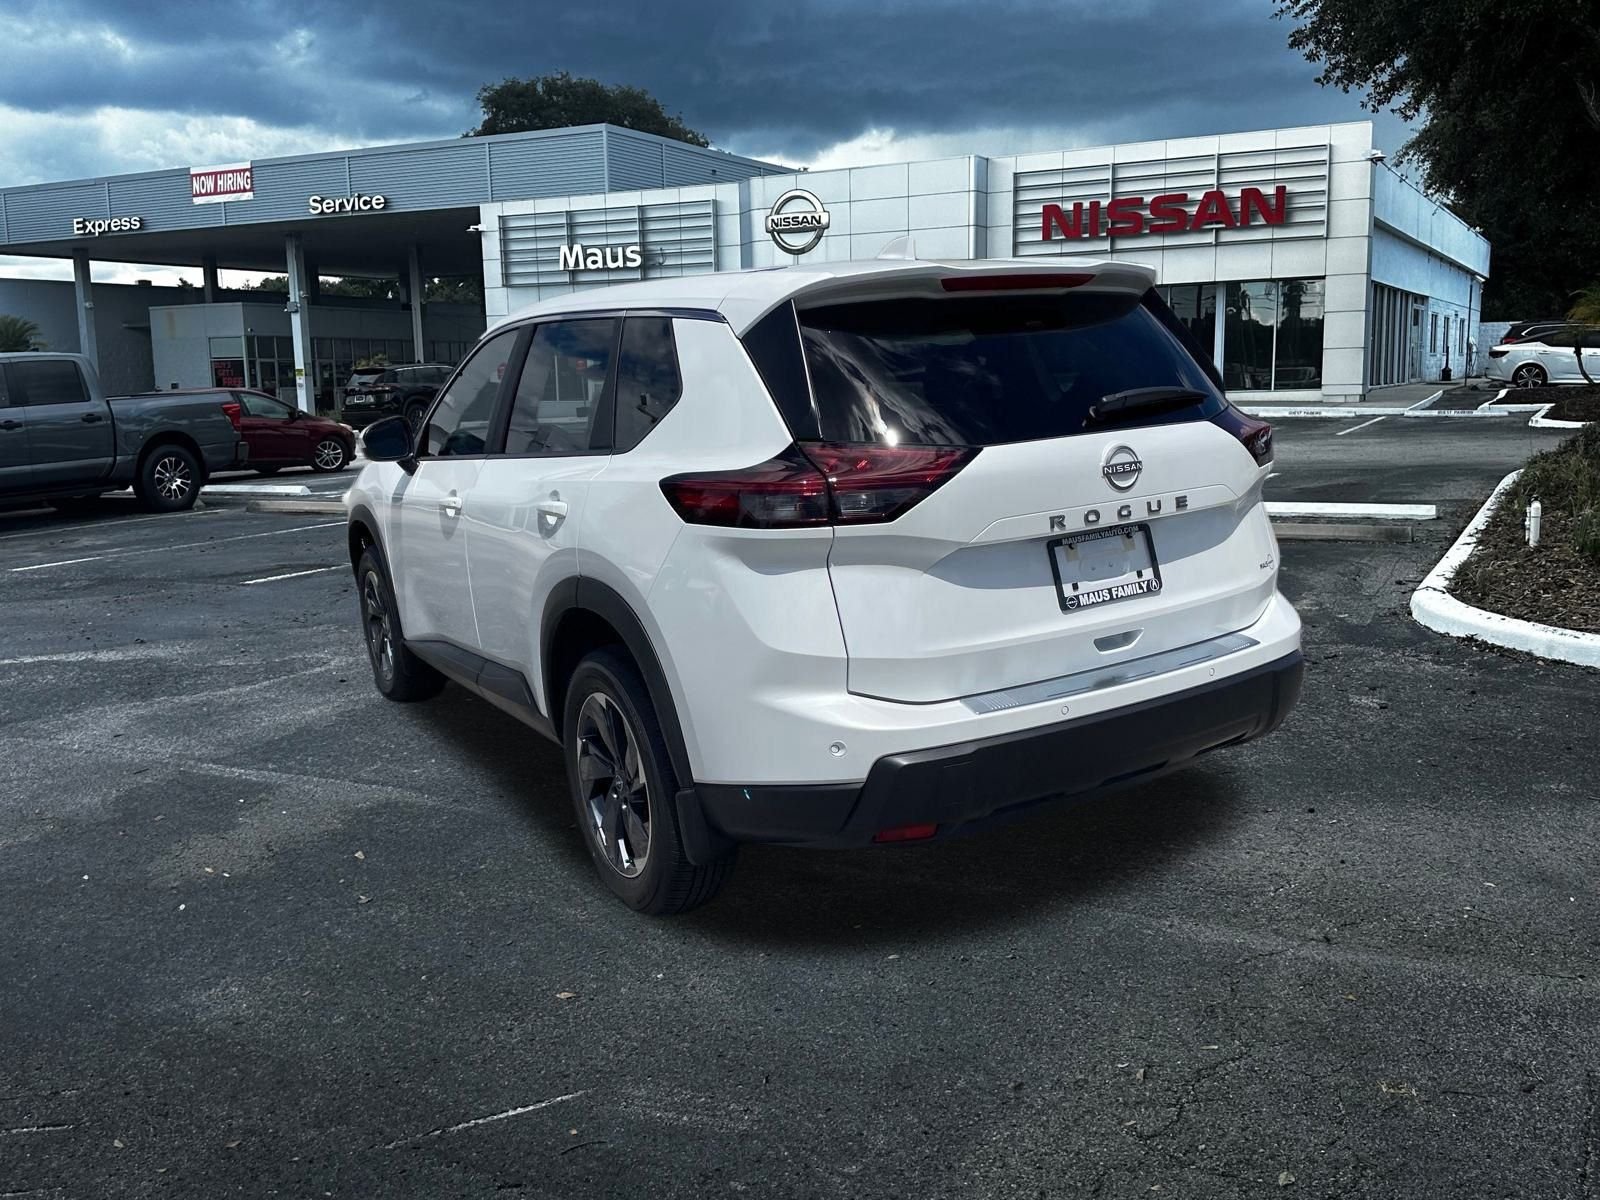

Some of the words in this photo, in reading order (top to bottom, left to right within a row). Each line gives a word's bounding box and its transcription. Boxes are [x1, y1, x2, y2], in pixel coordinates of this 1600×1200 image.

[192, 174, 215, 195] NOW
[217, 171, 251, 192] HIRING
[308, 193, 385, 215] Service
[1042, 185, 1287, 241] NISSAN
[73, 215, 141, 236] Express
[770, 214, 822, 229] NISSAN
[559, 243, 642, 271] Maus
[1104, 462, 1142, 474] NISSAN
[1049, 495, 1189, 530] ROGUE
[1062, 525, 1139, 546] MAUSFAMILYAUTO.COM
[1079, 590, 1111, 607] MAUS
[1111, 580, 1148, 599] FAMILY
